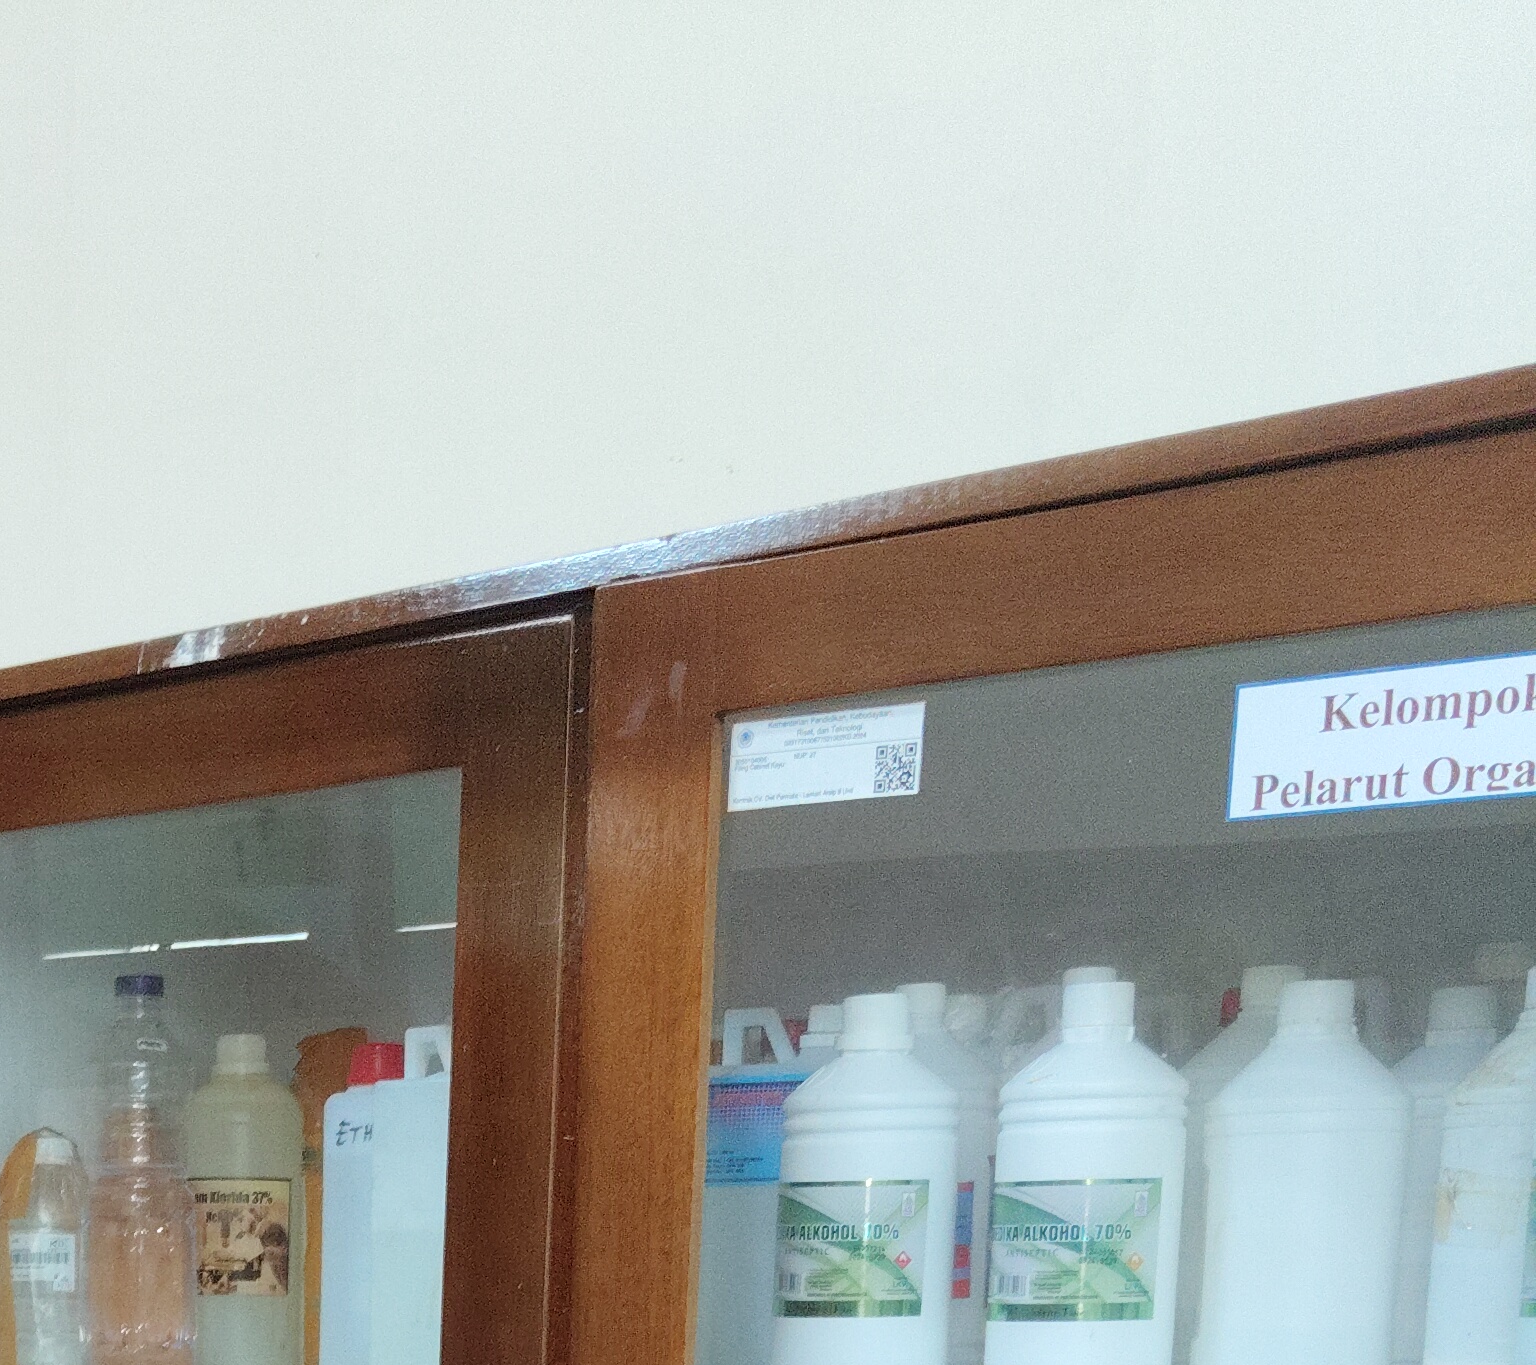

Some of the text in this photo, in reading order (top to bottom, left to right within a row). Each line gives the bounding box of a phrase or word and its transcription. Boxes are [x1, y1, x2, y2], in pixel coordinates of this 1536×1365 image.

[1249, 763, 1410, 812] Pelarut
[336, 1120, 374, 1146] ETH
[799, 1224, 857, 1241] ALKOHOL
[1023, 1224, 1089, 1242] ALKOHOL
[1095, 1223, 1132, 1241] 70%
